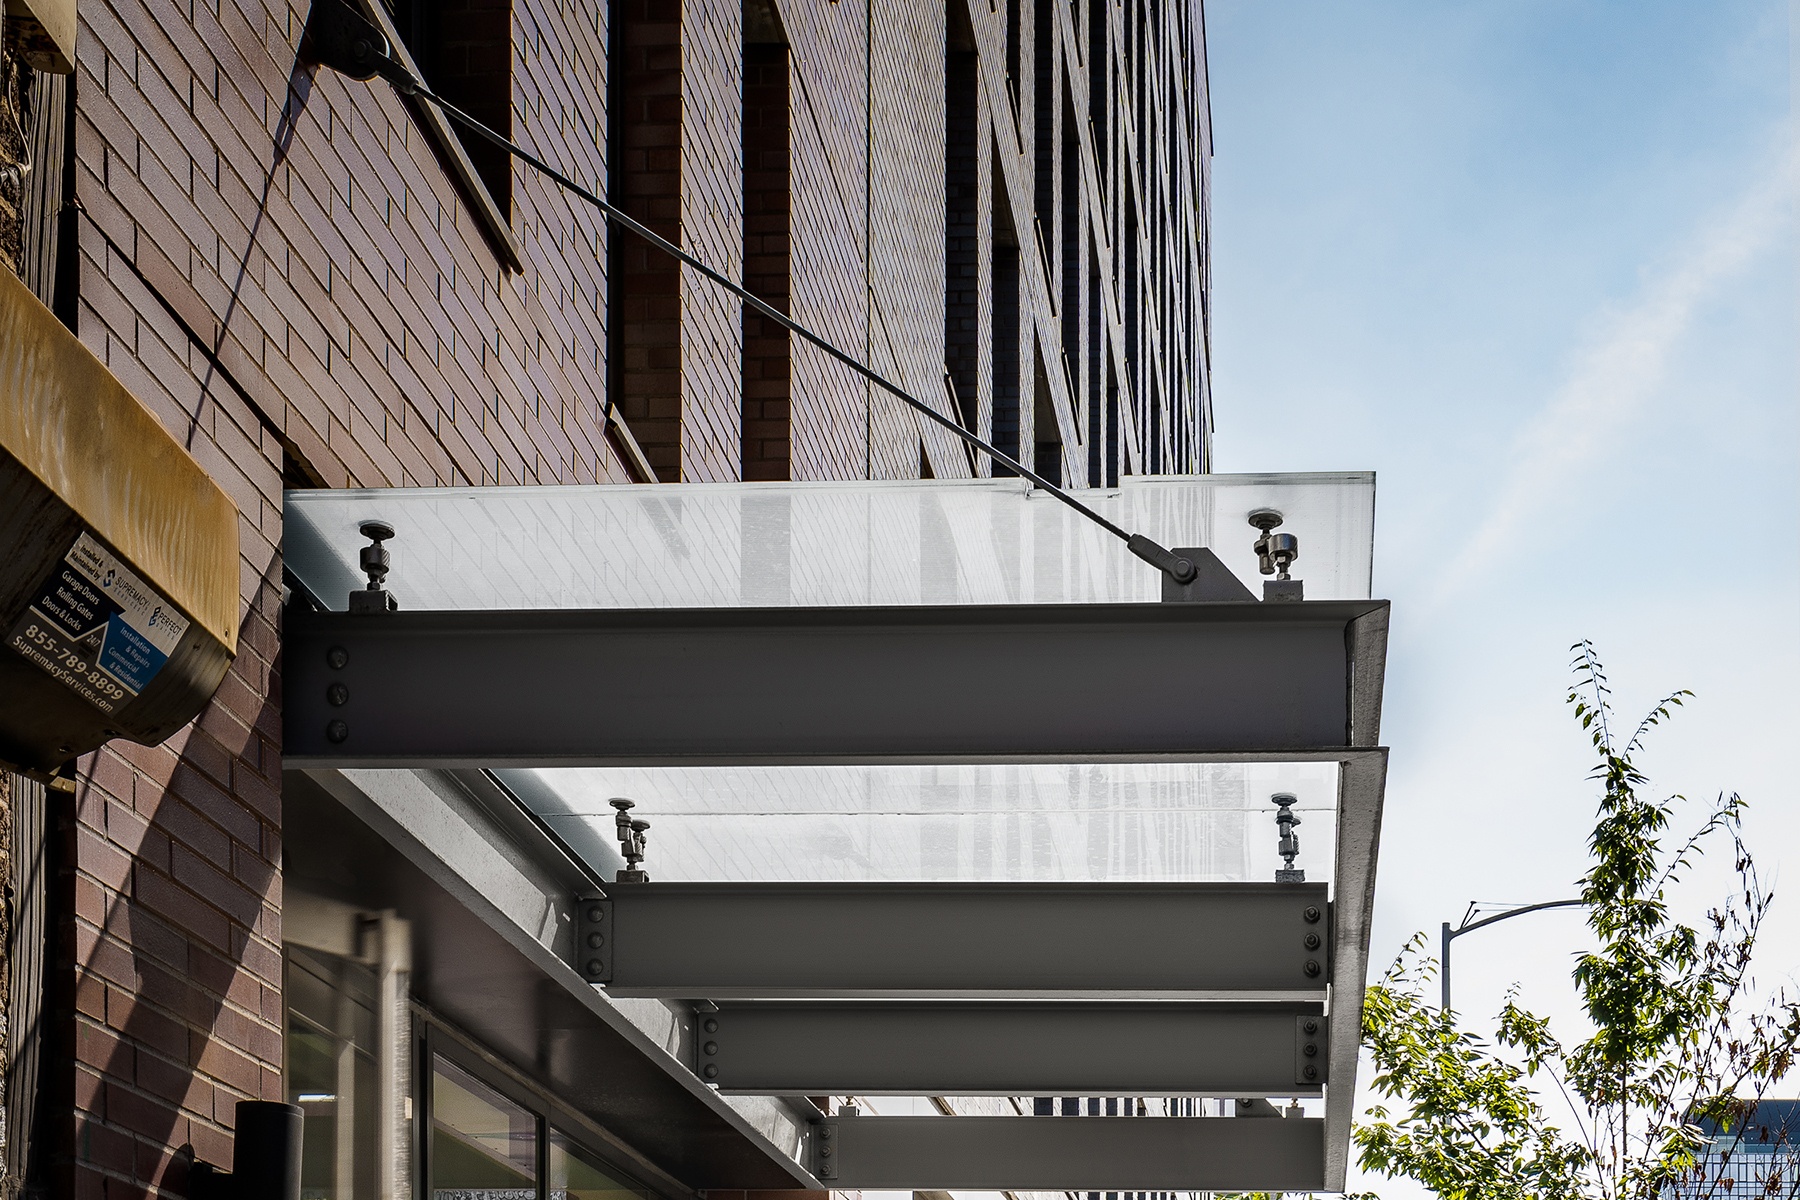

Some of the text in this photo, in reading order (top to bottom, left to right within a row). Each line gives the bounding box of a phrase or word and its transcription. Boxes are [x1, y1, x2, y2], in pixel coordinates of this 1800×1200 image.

[70, 551, 94, 576] Maintained
[80, 544, 99, 564] Installed
[62, 570, 100, 605] Garage Doors
[115, 576, 149, 608] SUPREMACY
[41, 595, 61, 615] Doors
[64, 613, 82, 631] Locks
[56, 586, 94, 620] Rolling Gates
[158, 613, 182, 636] PERFECT
[86, 634, 101, 648] 24/7
[120, 627, 150, 655] Installation
[25, 624, 124, 700] 855-789-8899
[108, 647, 140, 674] Commercial
[130, 650, 151, 668] Repairs
[13, 635, 114, 713] SupremacyServices.com
[114, 663, 143, 690] Residential
